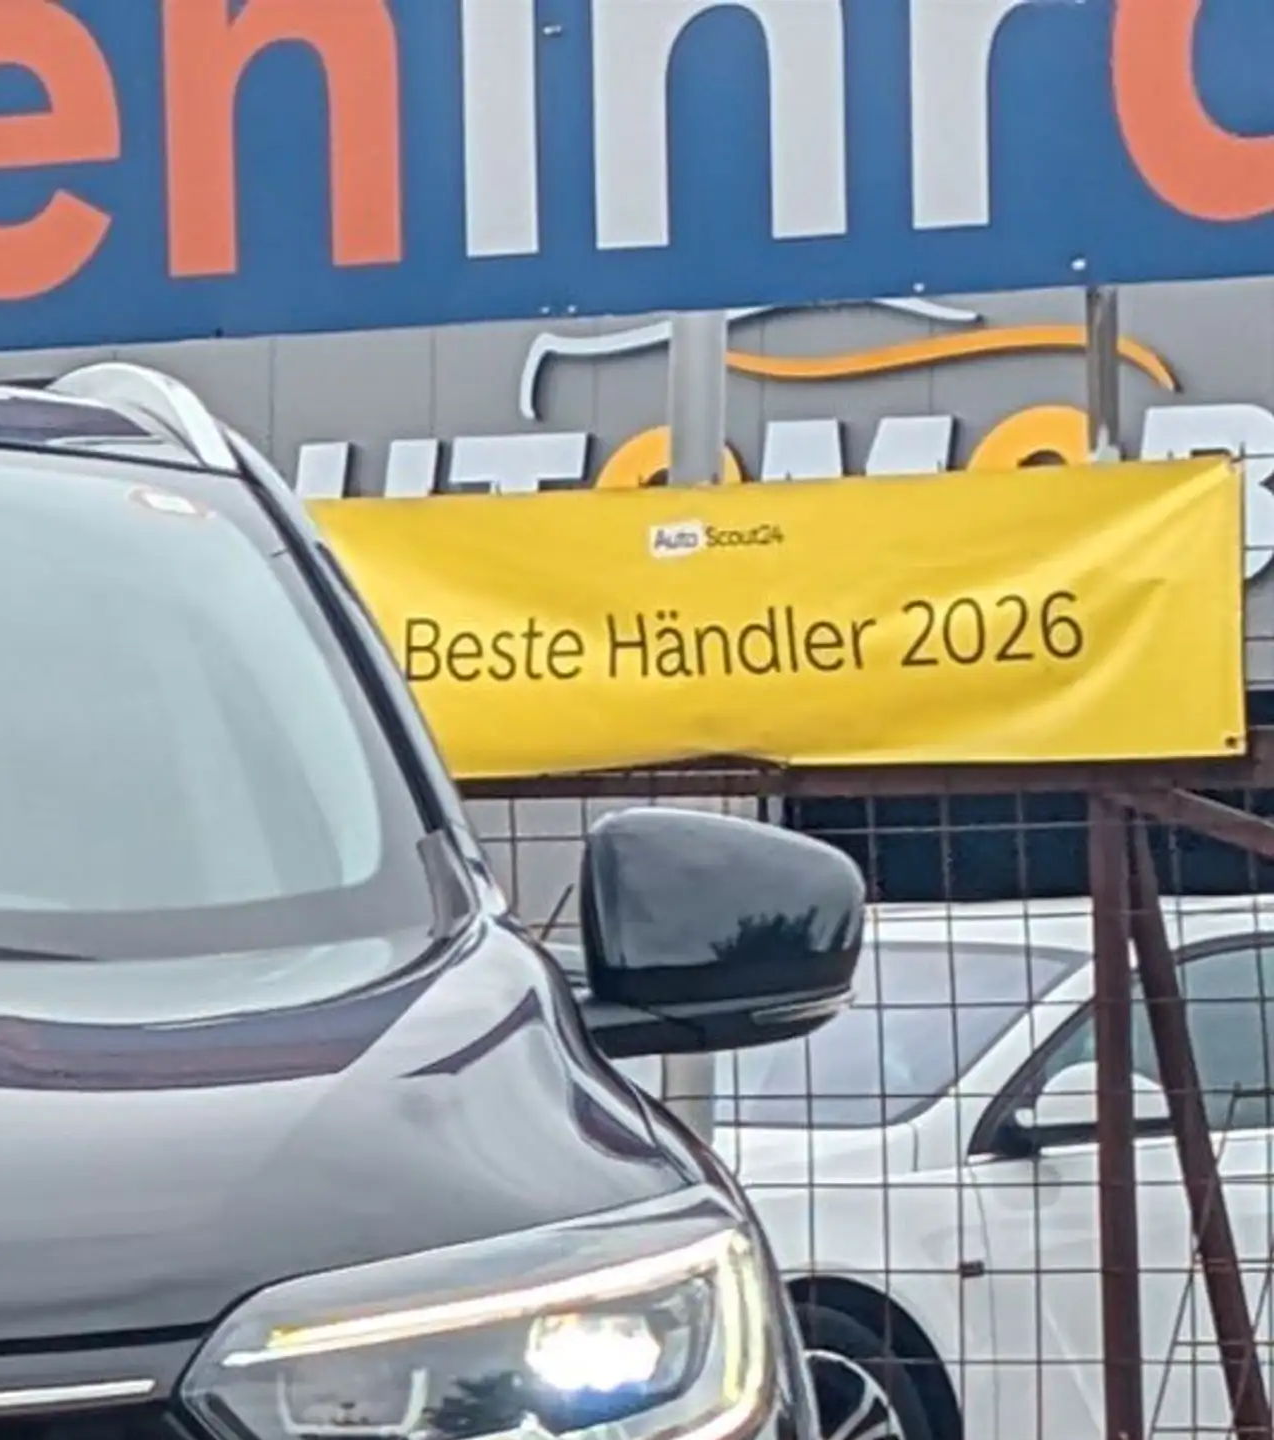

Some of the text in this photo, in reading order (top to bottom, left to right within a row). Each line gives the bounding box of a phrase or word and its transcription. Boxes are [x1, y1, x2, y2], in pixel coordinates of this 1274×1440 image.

[653, 523, 785, 549] Auto Scout24
[402, 588, 1085, 683] Beste Händler 2026
